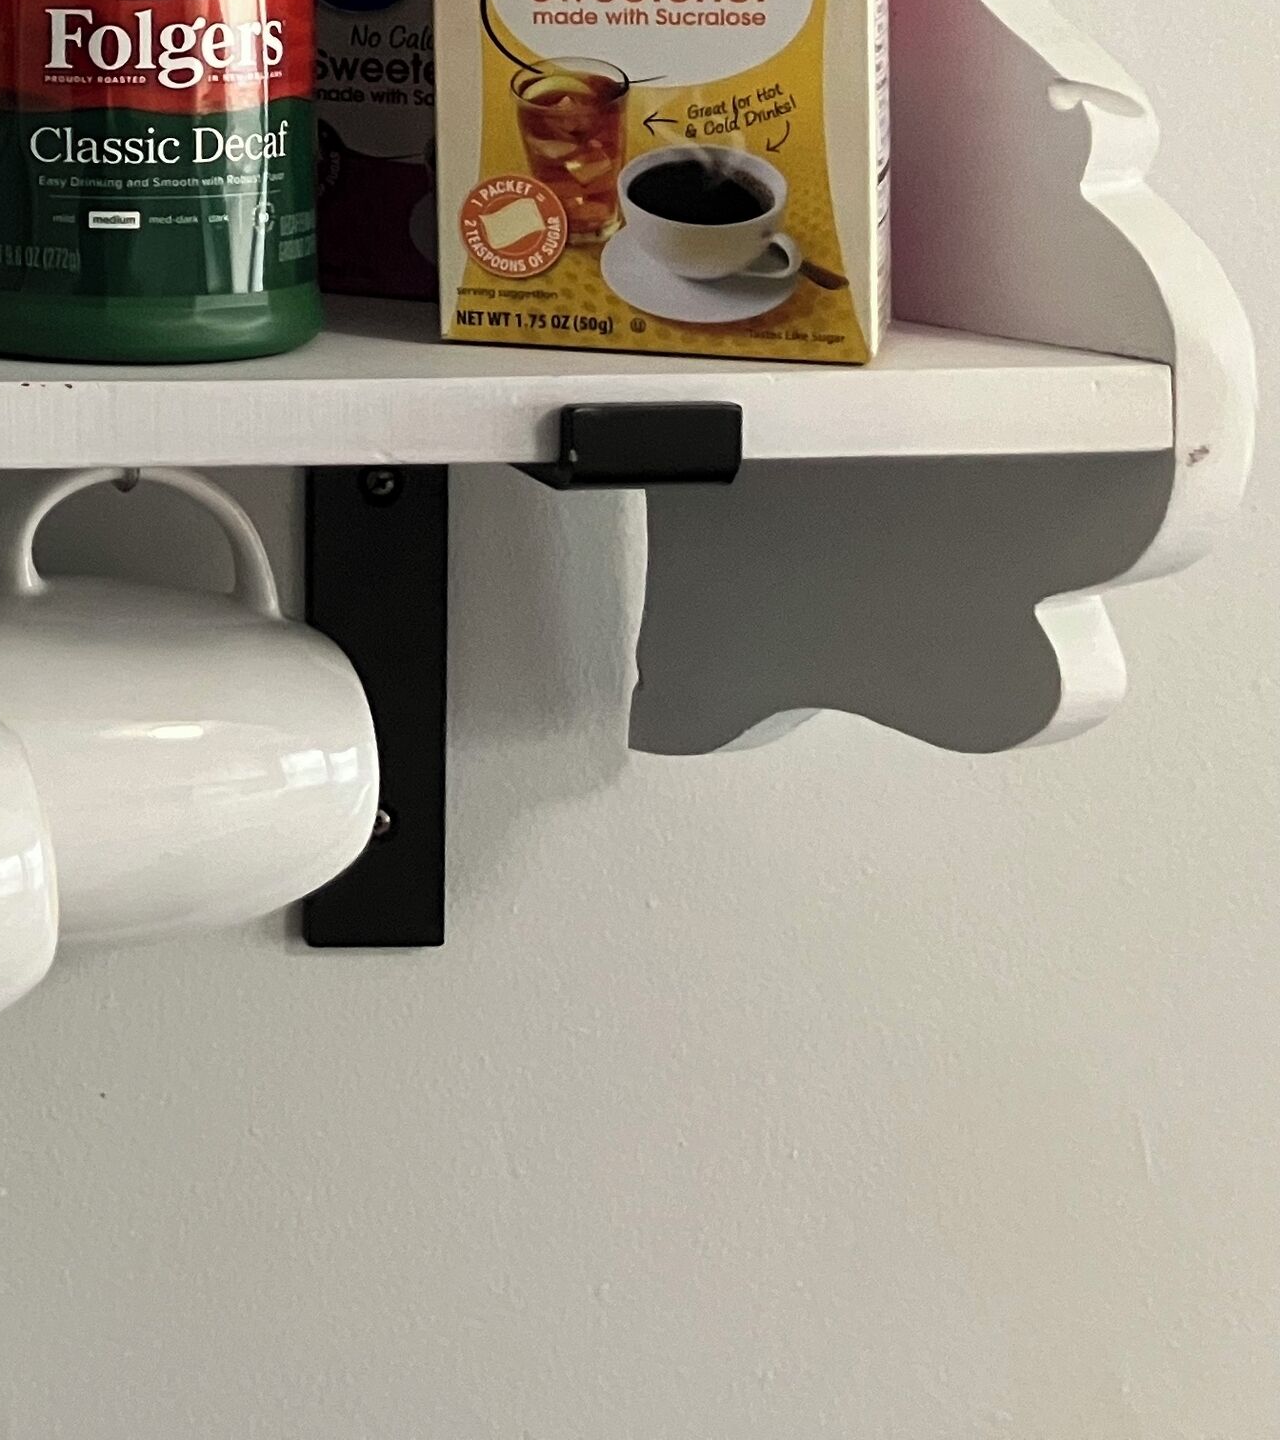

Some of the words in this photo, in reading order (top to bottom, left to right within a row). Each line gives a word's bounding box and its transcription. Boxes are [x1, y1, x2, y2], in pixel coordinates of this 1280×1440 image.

[533, 8, 598, 25] made
[605, 7, 649, 25] with
[655, 8, 766, 26] Sucralose
[350, 24, 381, 48] No
[44, 8, 284, 89] Folgers
[44, 75, 93, 85] PROUDLY
[97, 75, 147, 85] ROASTED
[687, 101, 728, 119] Great
[756, 83, 784, 103] Hot
[685, 123, 697, 138] &
[704, 117, 740, 136] Cold
[744, 94, 797, 128] Drinks!
[30, 126, 180, 164] Classic
[192, 120, 289, 163] Decaf
[39, 175, 67, 190] Easy
[70, 176, 123, 190] Drinking
[126, 176, 149, 188] and
[153, 176, 200, 188] Smooth
[202, 175, 224, 187] with
[479, 180, 533, 201] PACKET
[93, 214, 136, 225] medium
[464, 220, 477, 228] 2
[541, 216, 560, 256] SUGAR
[466, 229, 527, 272] TEASPOONS
[528, 252, 544, 268] OF
[456, 311, 484, 327] NET
[488, 311, 511, 328] WT
[515, 312, 546, 329] 1.75
[550, 313, 571, 329] OZ
[573, 314, 614, 335] (50g)
